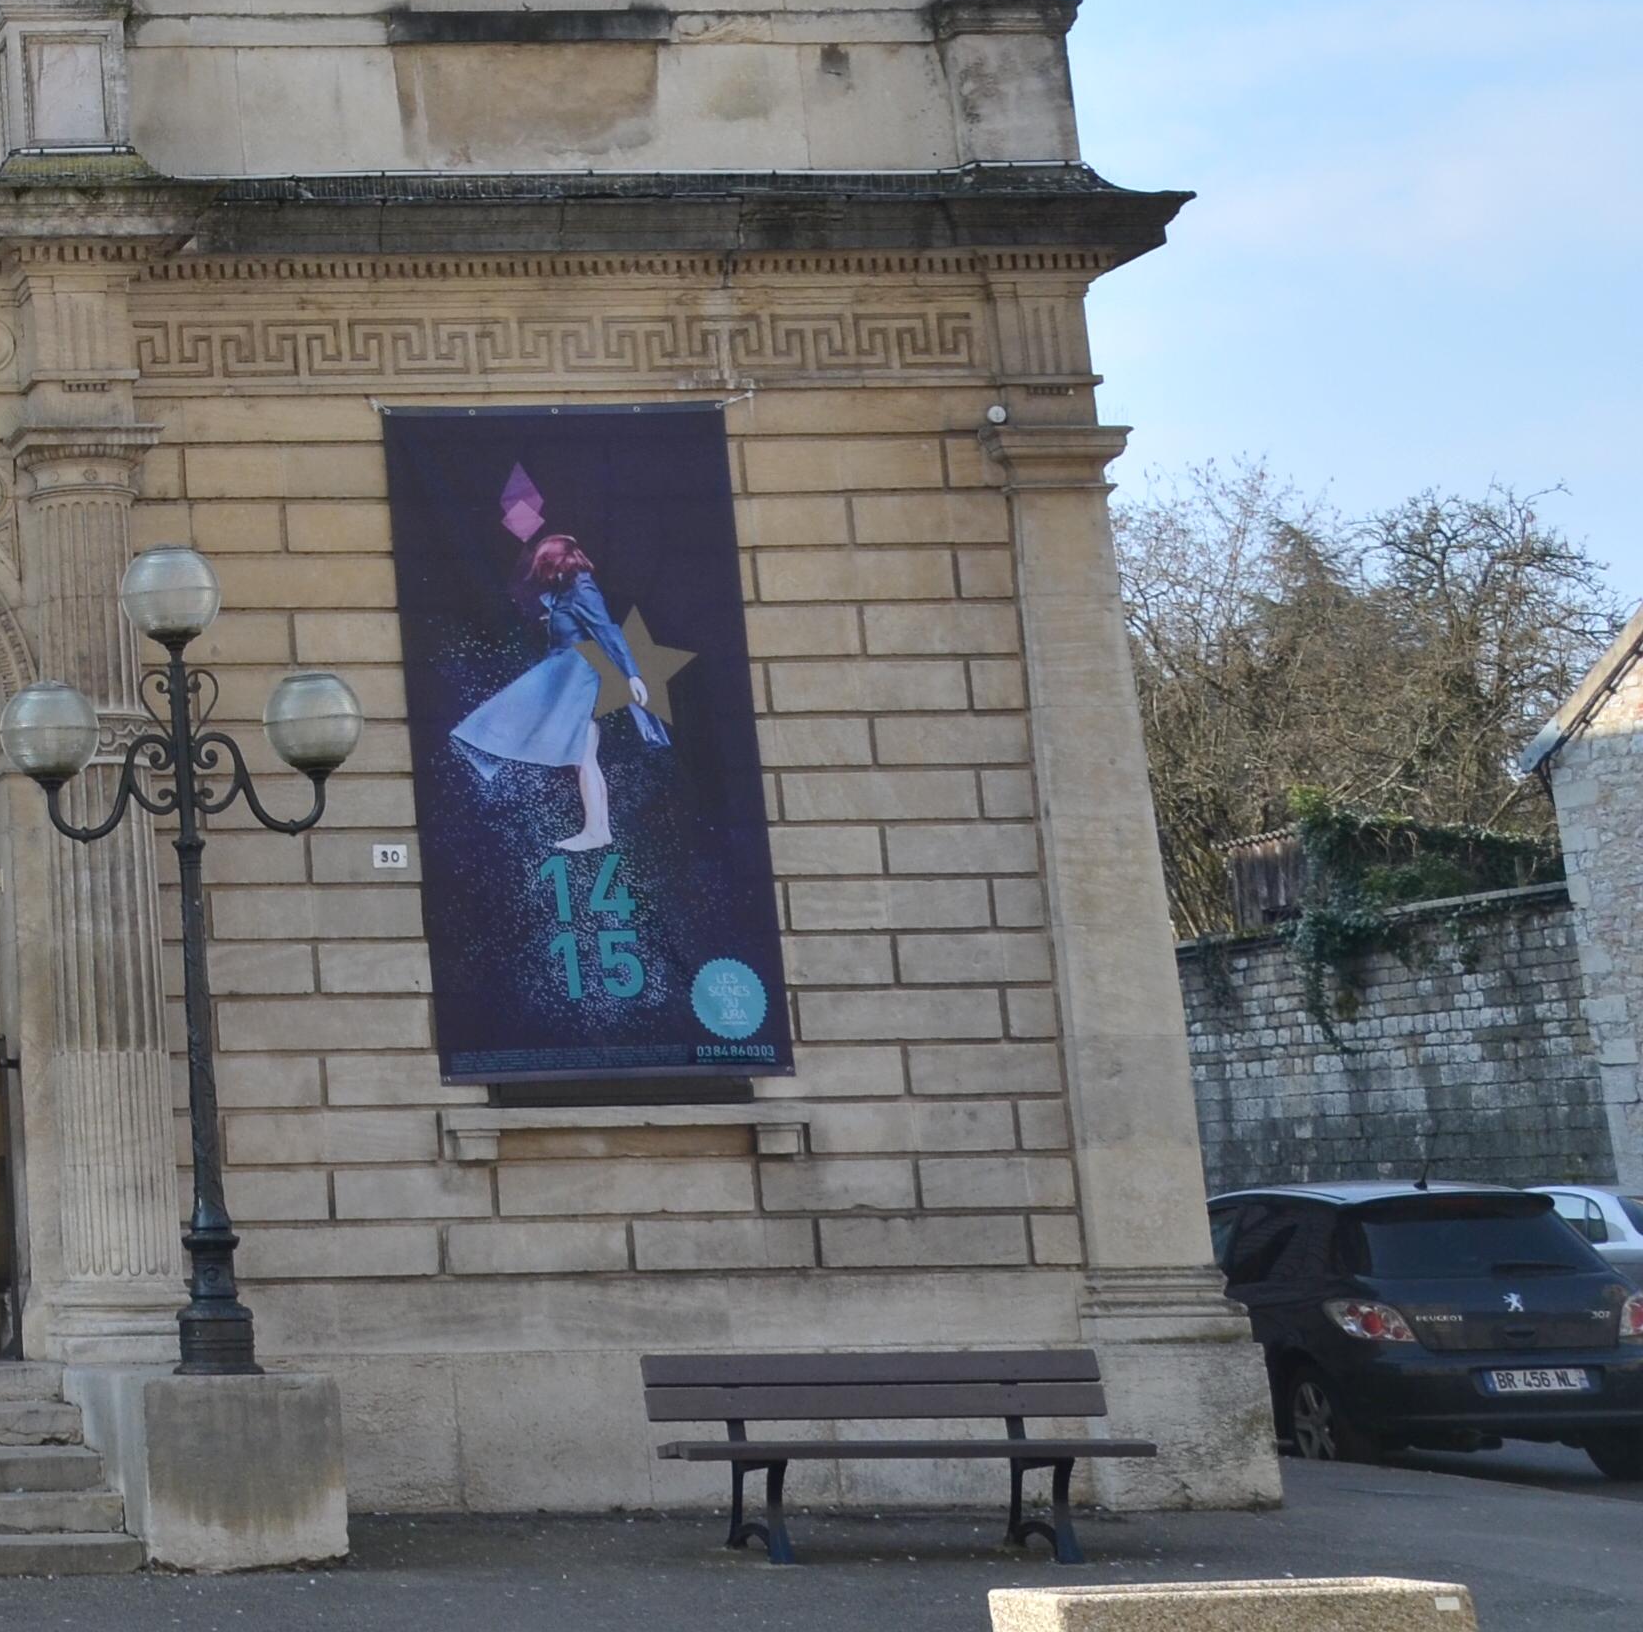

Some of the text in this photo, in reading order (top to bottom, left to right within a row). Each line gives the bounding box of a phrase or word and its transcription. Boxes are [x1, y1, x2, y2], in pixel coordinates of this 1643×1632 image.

[380, 850, 400, 863] 30
[540, 854, 636, 922] 14
[548, 930, 645, 999] 15
[716, 973, 738, 984] LES
[722, 997, 739, 1008] DU
[720, 1009, 748, 1020] JURA
[1591, 1310, 1611, 1319] 307
